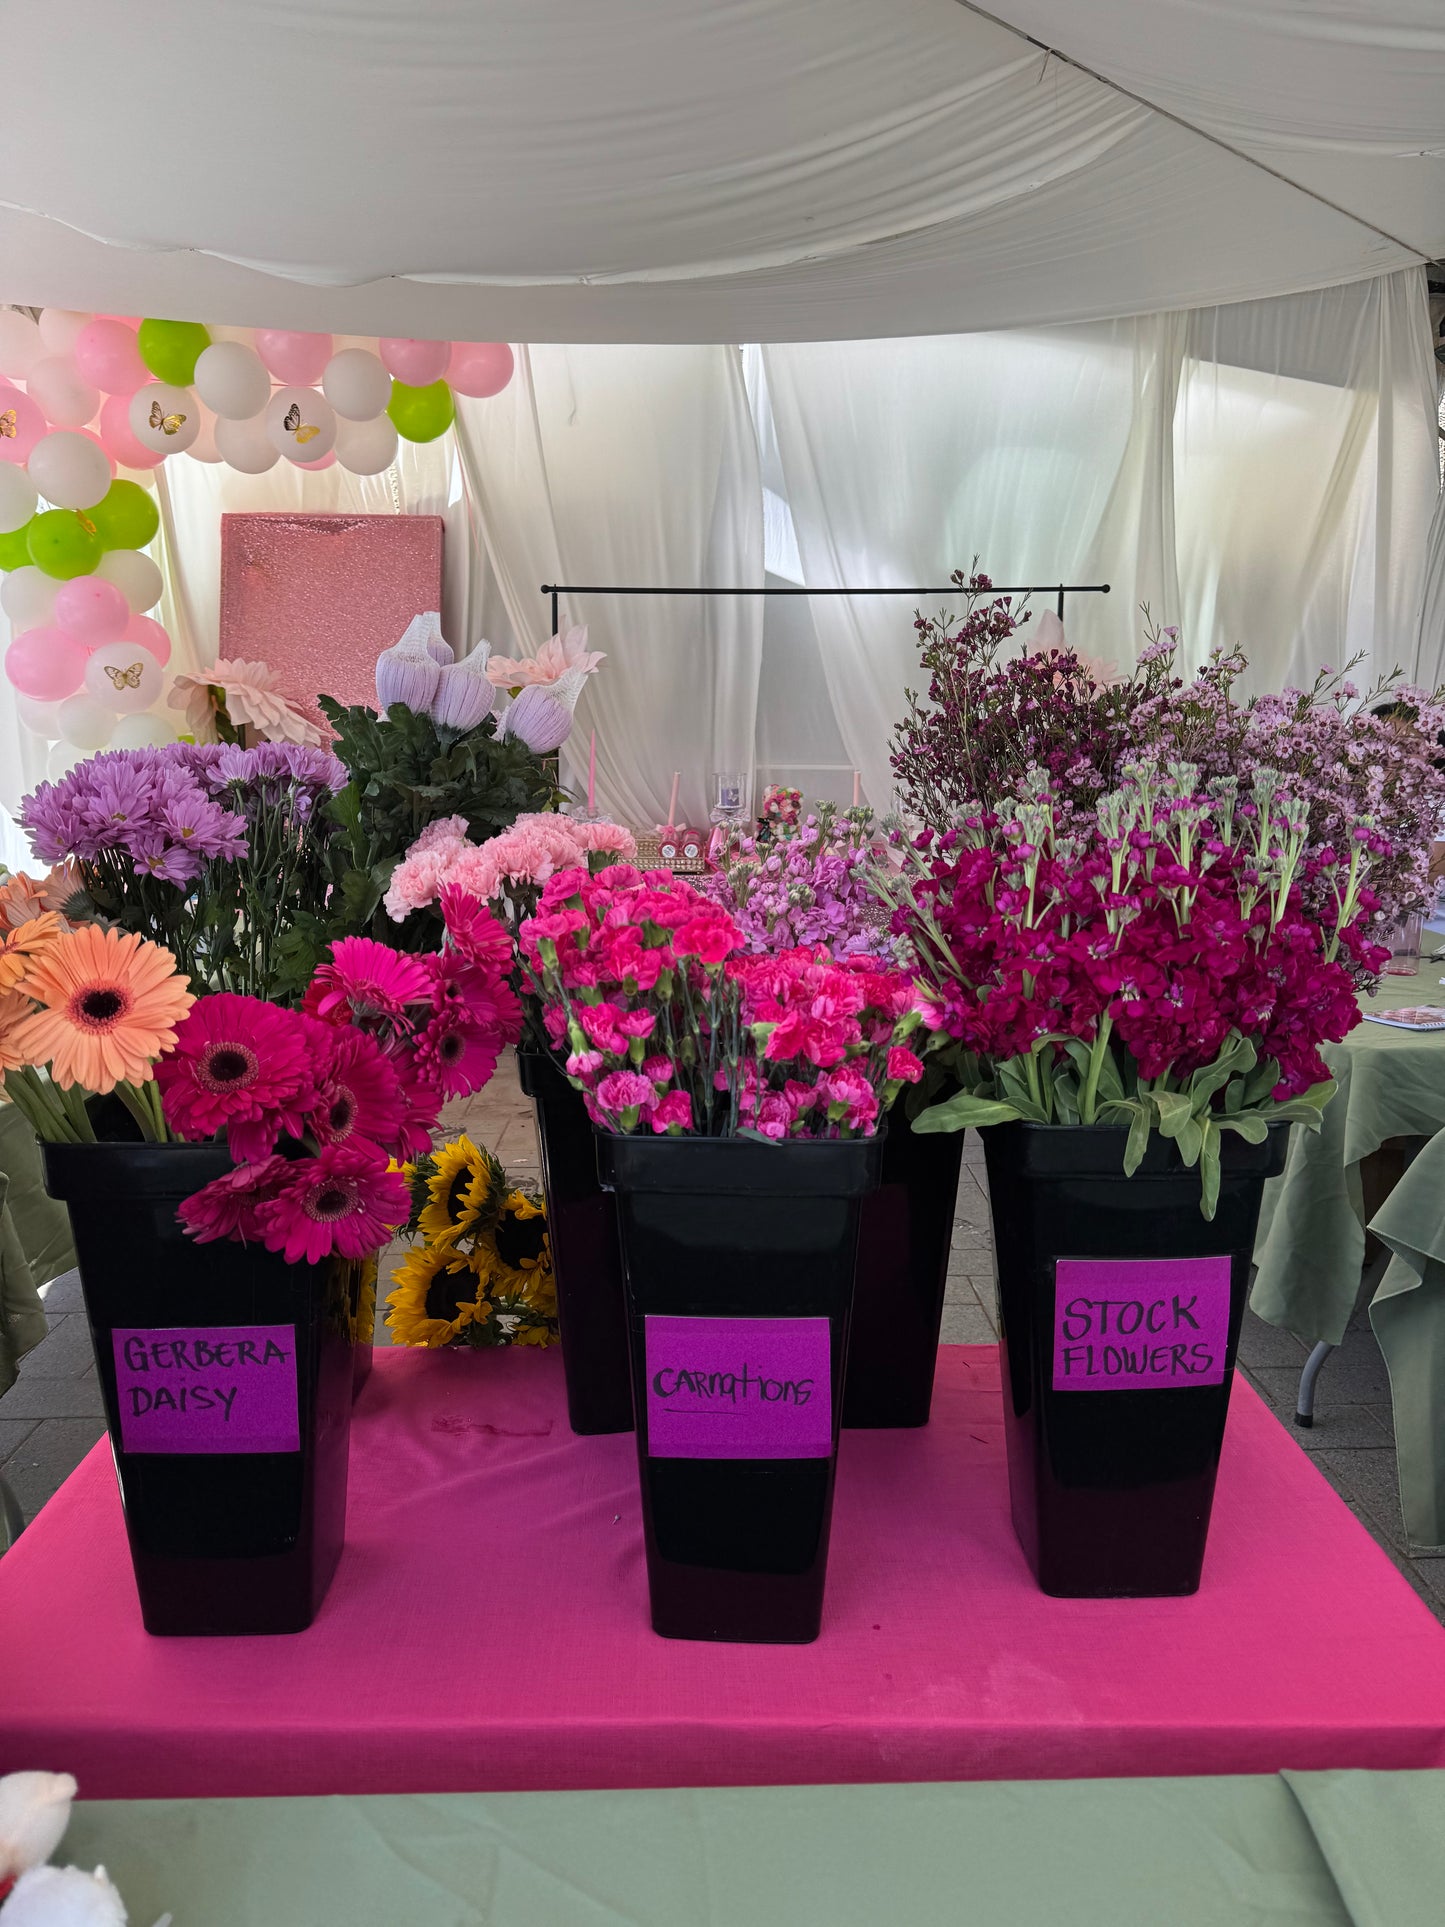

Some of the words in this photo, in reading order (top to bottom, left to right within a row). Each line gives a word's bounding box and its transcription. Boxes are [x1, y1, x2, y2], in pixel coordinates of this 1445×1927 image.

[1062, 1295, 1200, 1341] STOCK
[124, 1336, 291, 1371] GERBERA
[1061, 1343, 1214, 1376] FLOWERS
